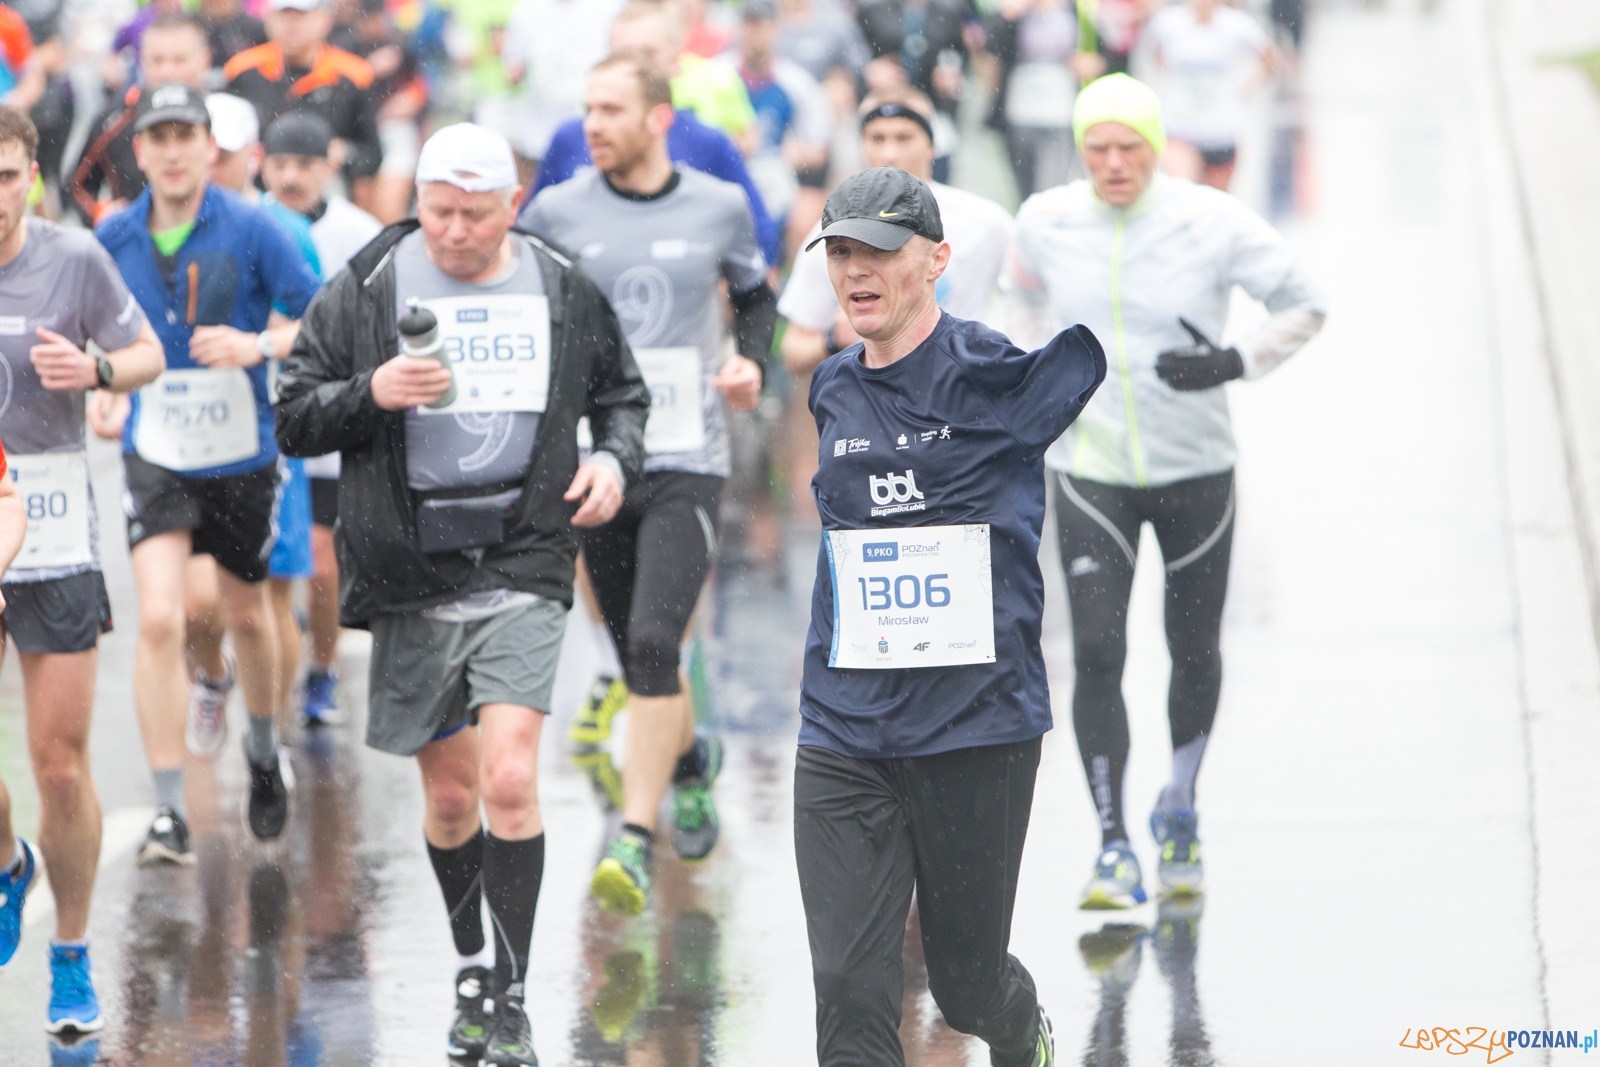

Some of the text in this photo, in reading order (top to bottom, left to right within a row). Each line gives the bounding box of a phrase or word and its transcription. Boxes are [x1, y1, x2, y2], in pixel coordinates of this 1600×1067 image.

[868, 469, 925, 505] bbl
[27, 490, 68, 520] 80
[858, 573, 951, 611] 1306
[878, 615, 929, 627] Mirosław
